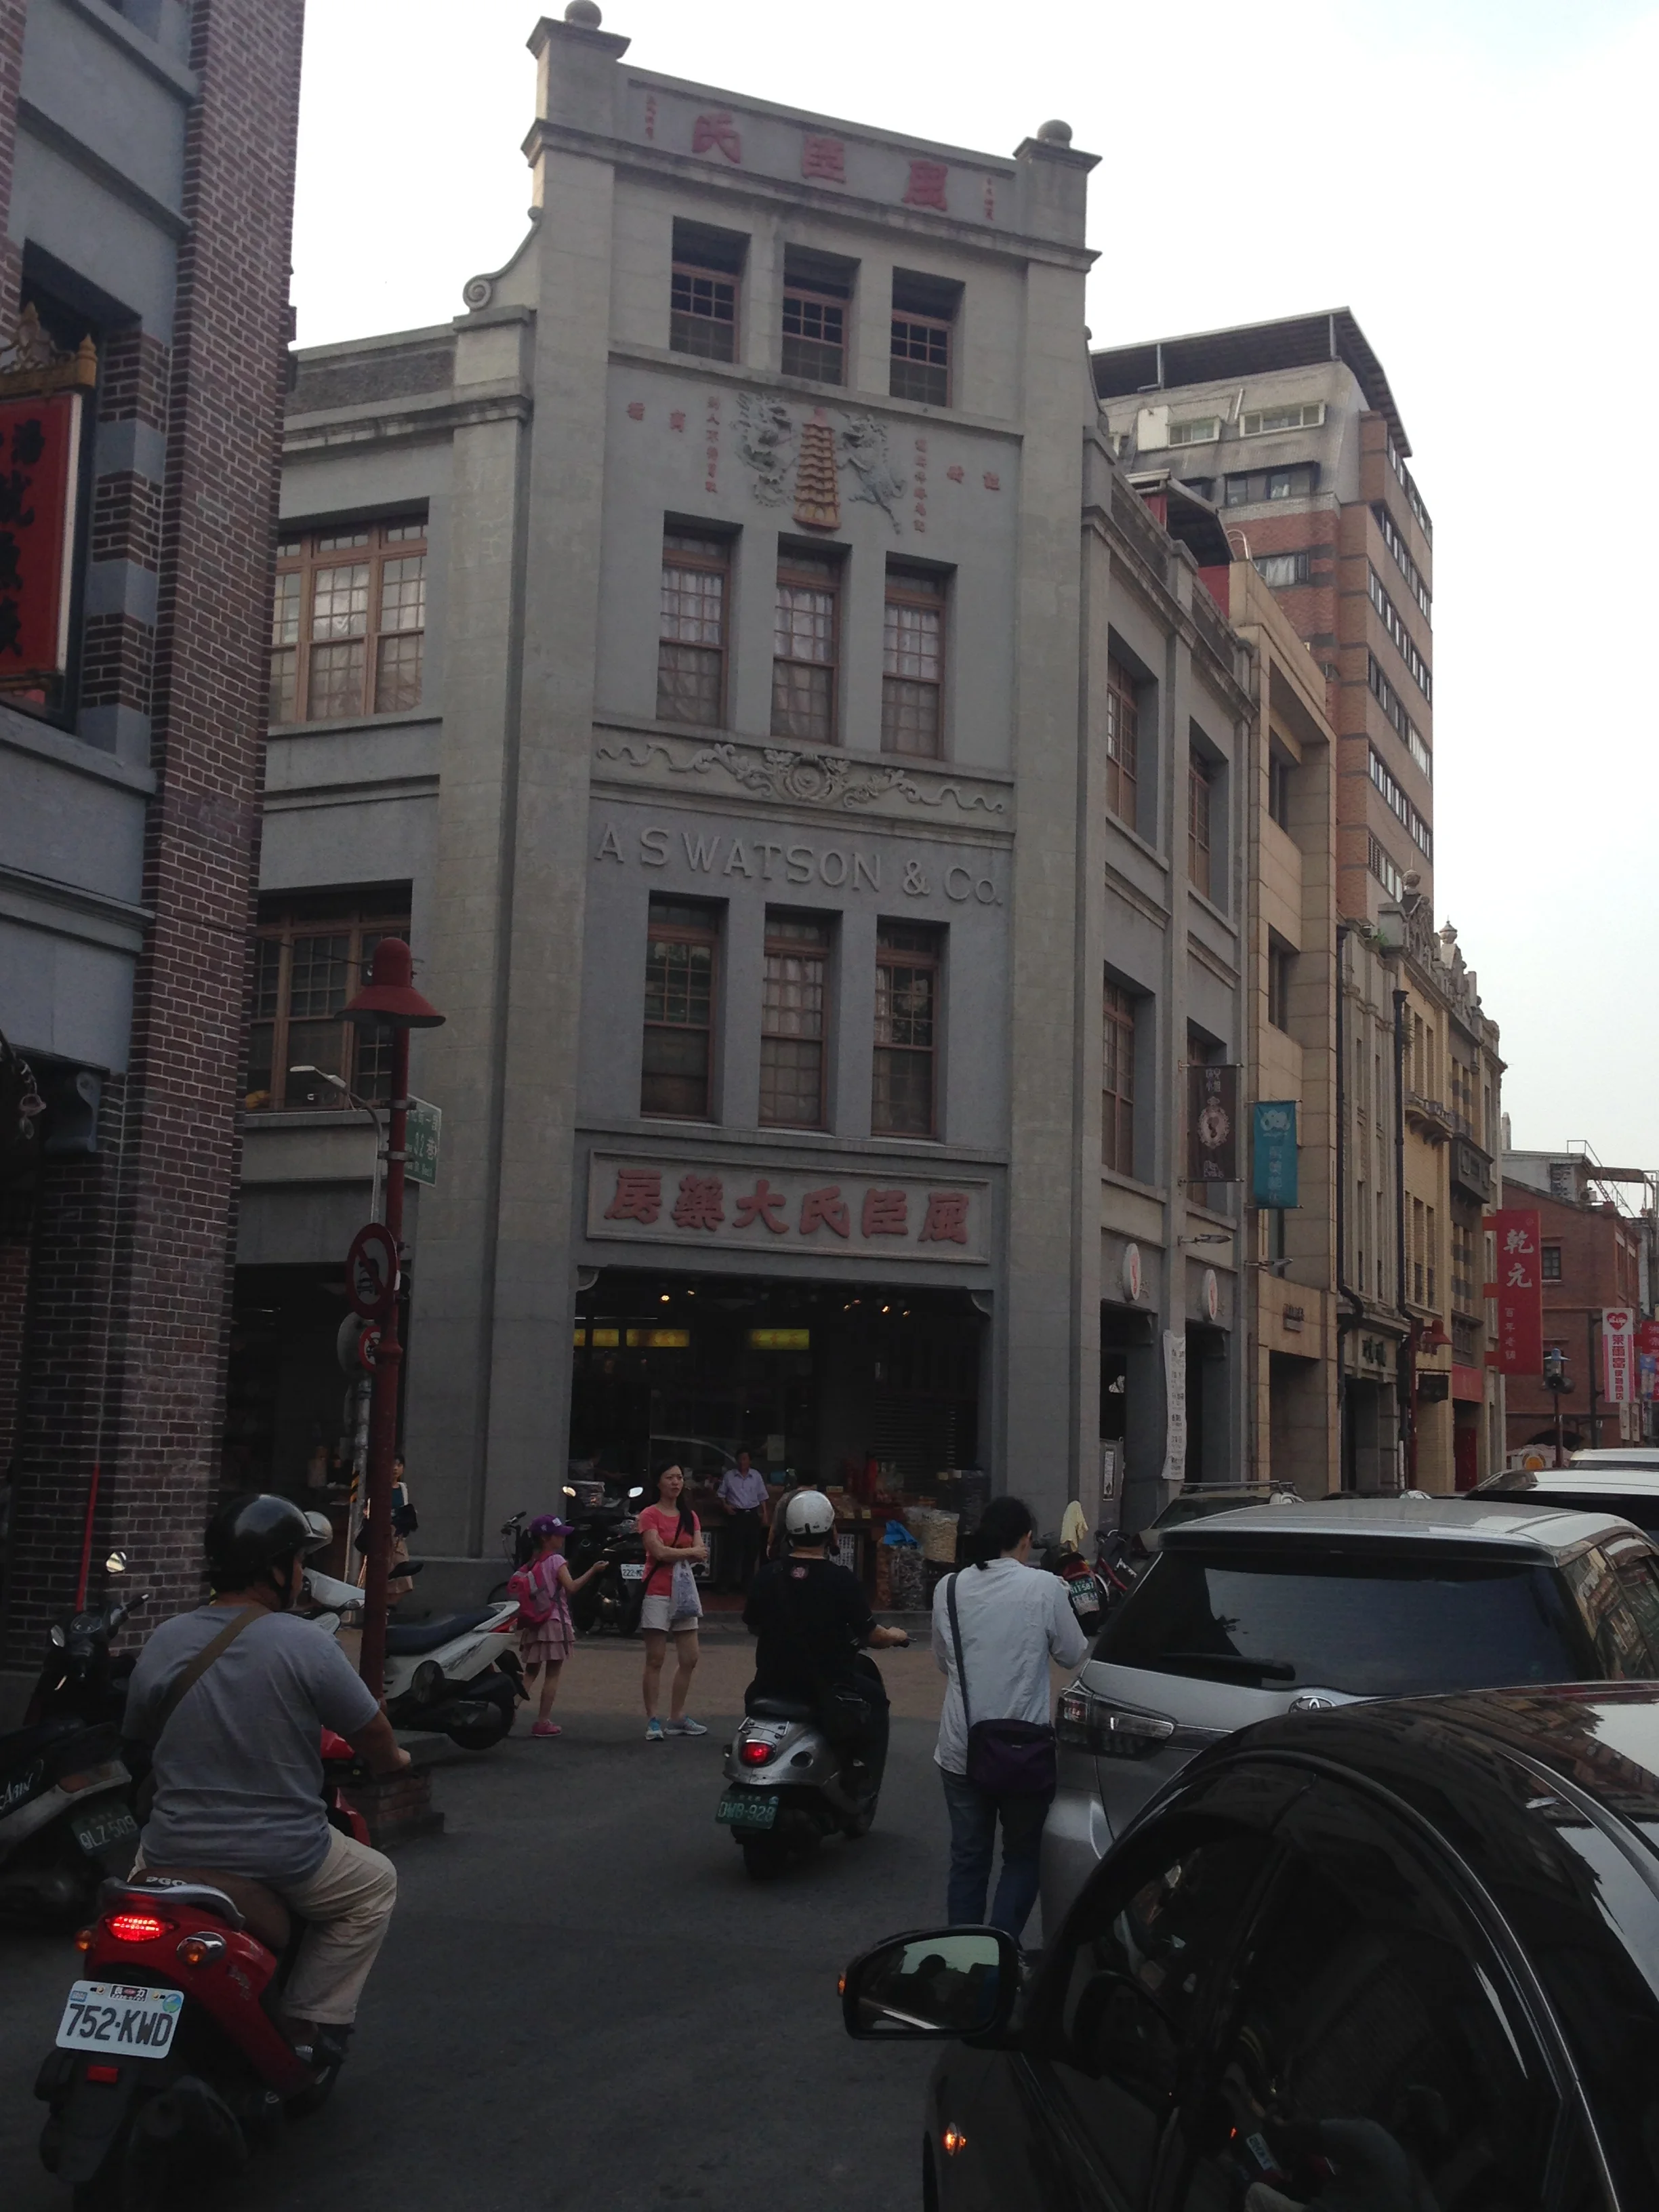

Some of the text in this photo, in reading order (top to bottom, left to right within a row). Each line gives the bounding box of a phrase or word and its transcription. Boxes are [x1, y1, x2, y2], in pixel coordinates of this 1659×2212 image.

[594, 821, 624, 863] A
[640, 826, 670, 867] S
[681, 832, 883, 893] WATSON
[902, 859, 930, 896] &
[1503, 1228, 1534, 1288] 乾元
[145, 1876, 187, 1887] PGO
